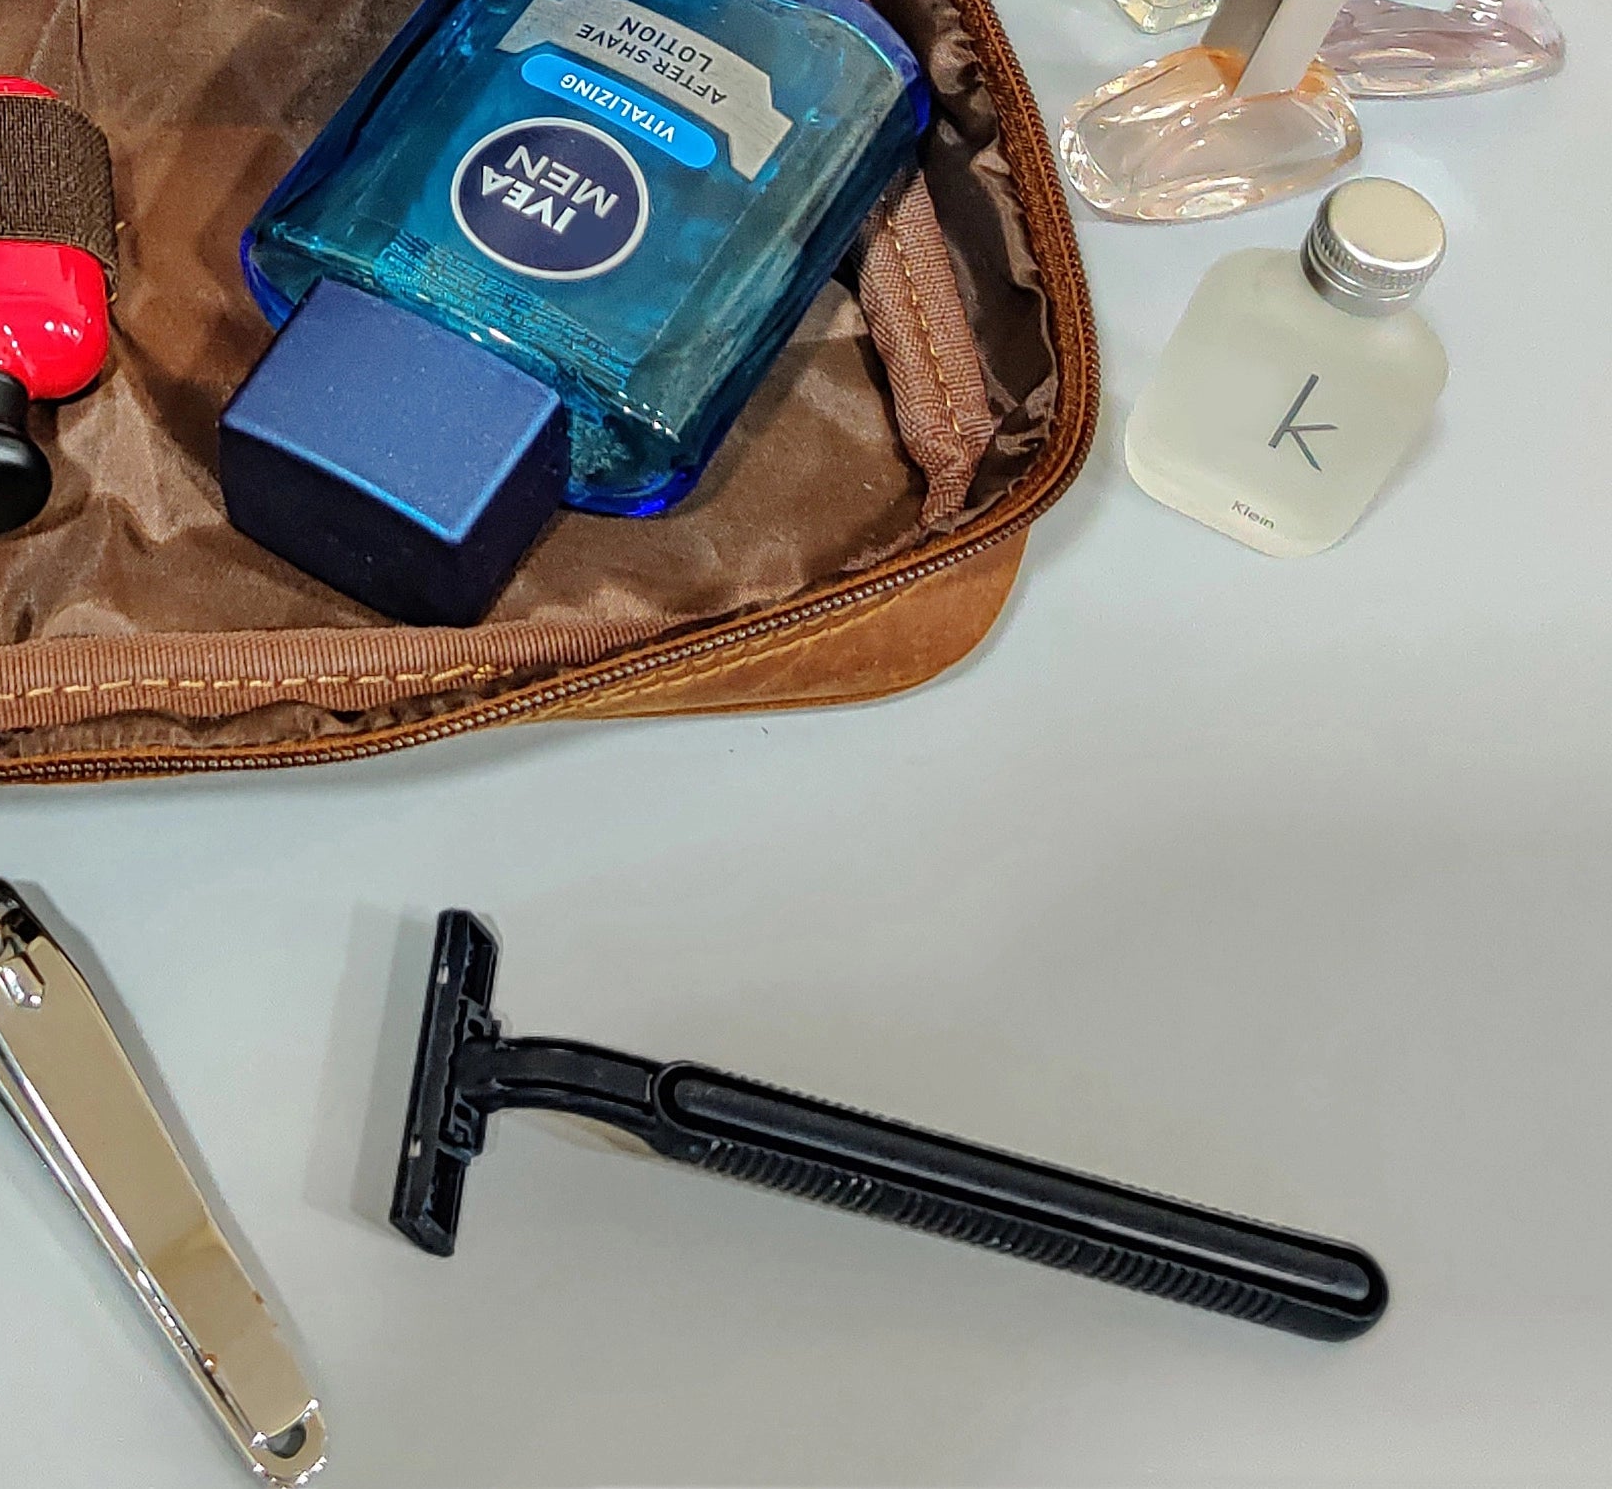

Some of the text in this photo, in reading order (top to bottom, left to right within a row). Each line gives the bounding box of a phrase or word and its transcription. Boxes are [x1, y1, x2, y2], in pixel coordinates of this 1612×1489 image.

[575, 22, 728, 106] AFTER SHAVE
[618, 16, 714, 73] LOTION
[559, 72, 676, 144] VITALIZING
[481, 164, 577, 236] IVEA
[504, 144, 619, 219] MEN
[1231, 500, 1275, 529] Klein
